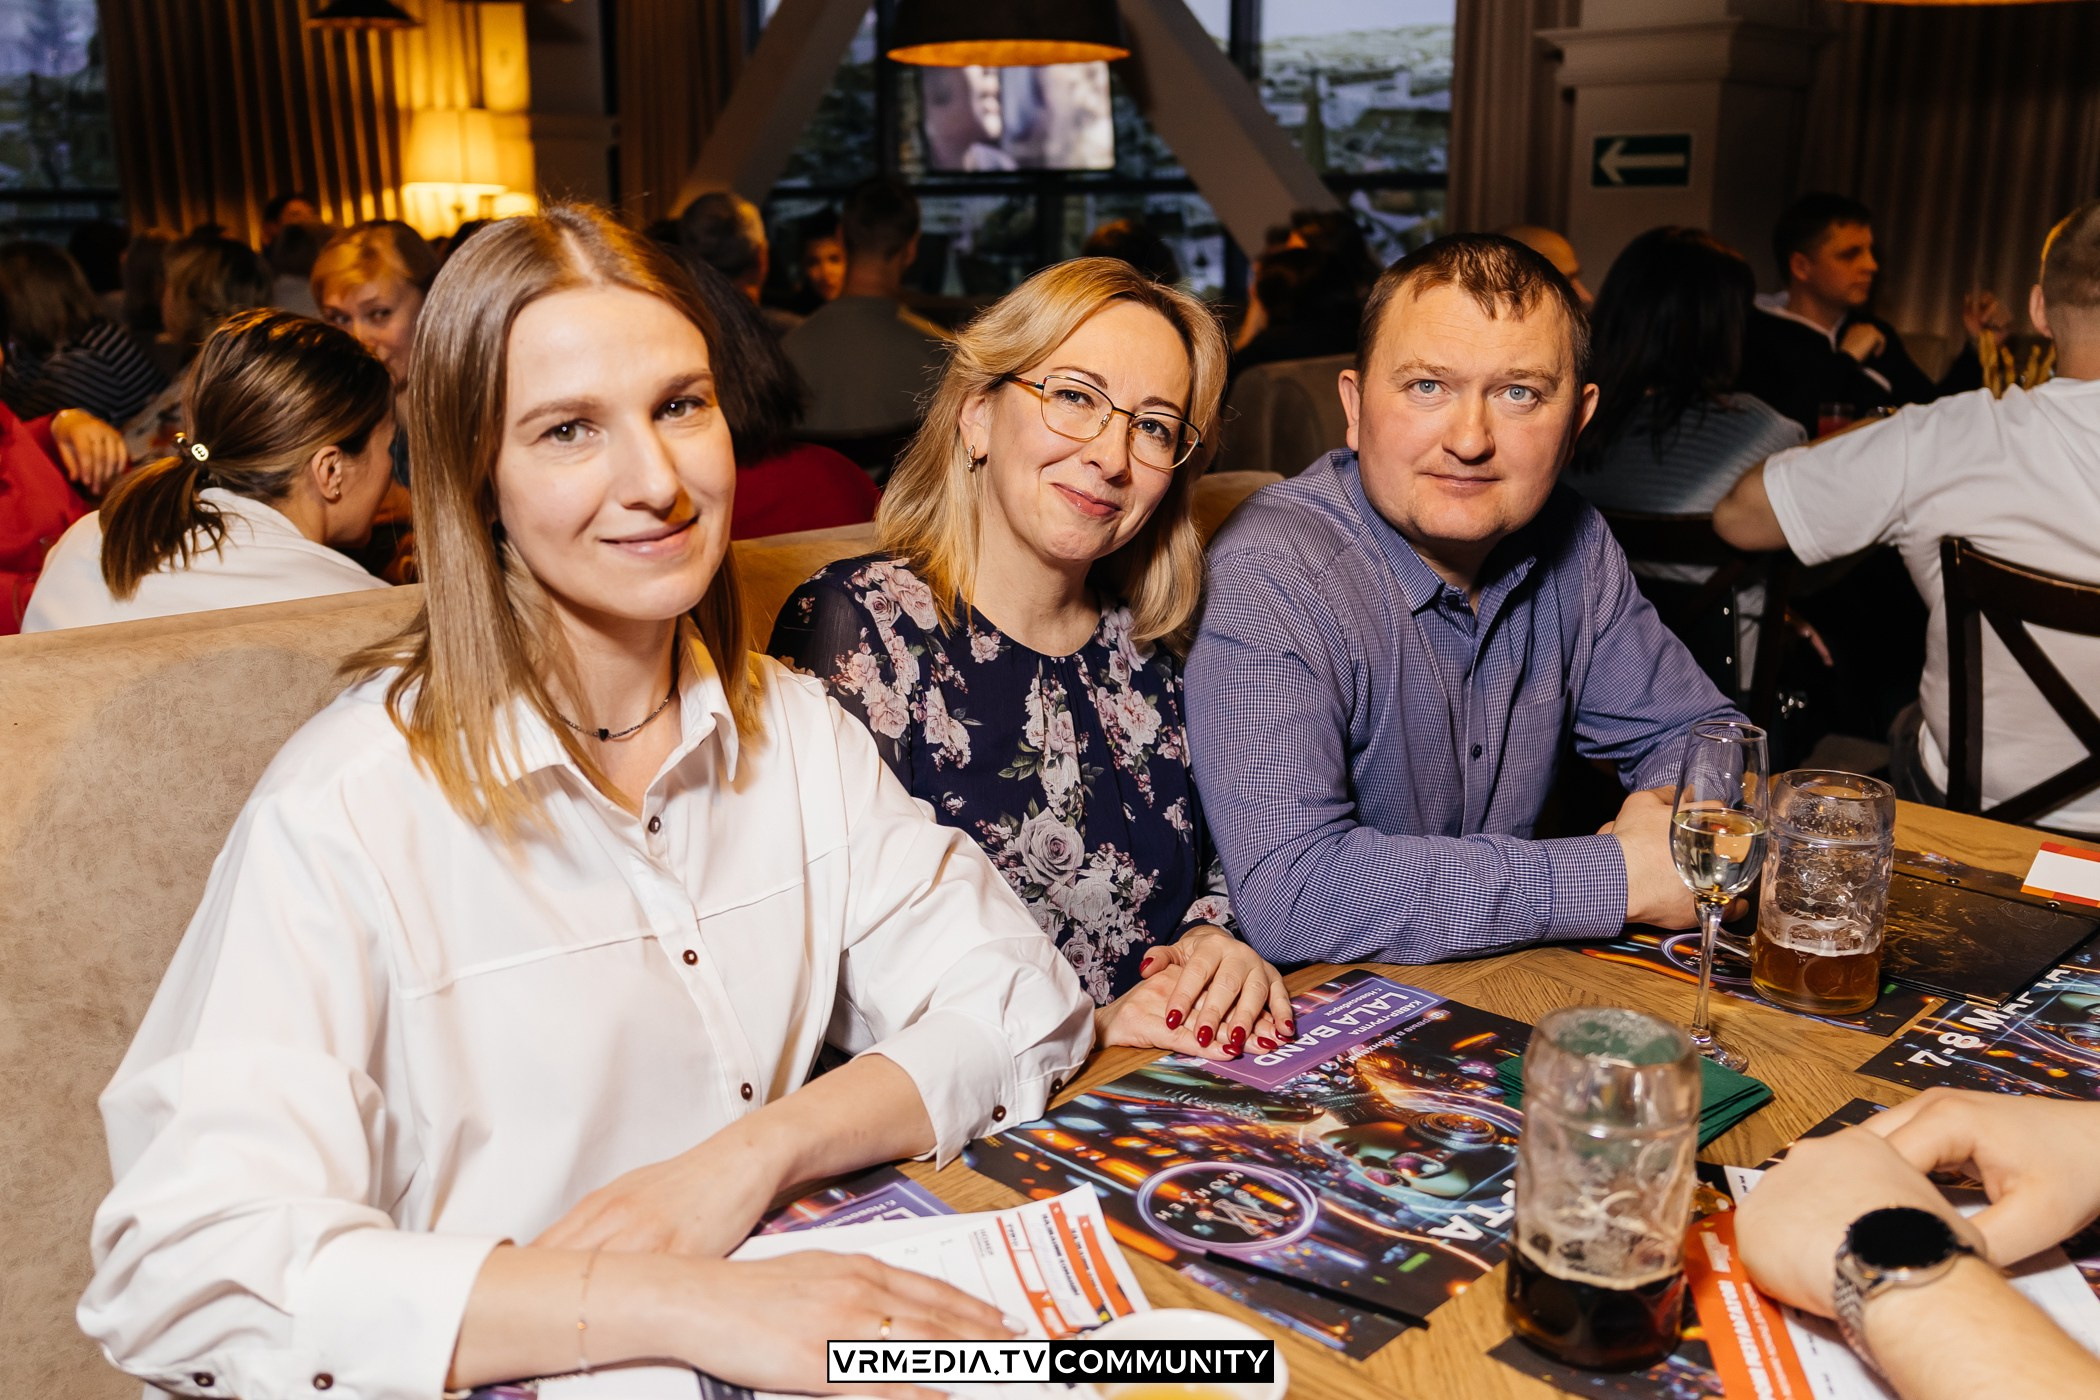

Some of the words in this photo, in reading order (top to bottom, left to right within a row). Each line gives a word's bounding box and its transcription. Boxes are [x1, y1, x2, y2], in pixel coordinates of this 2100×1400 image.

[1323, 989, 1378, 1017] Новосибирск
[1330, 991, 1410, 1027] LALA
[1348, 999, 1424, 1036] КАВЕР-ГРУППА
[1253, 1024, 1342, 1067] BAND
[1907, 1031, 1982, 1067] 7-8
[1154, 1170, 1244, 1222] МЮНХЕН
